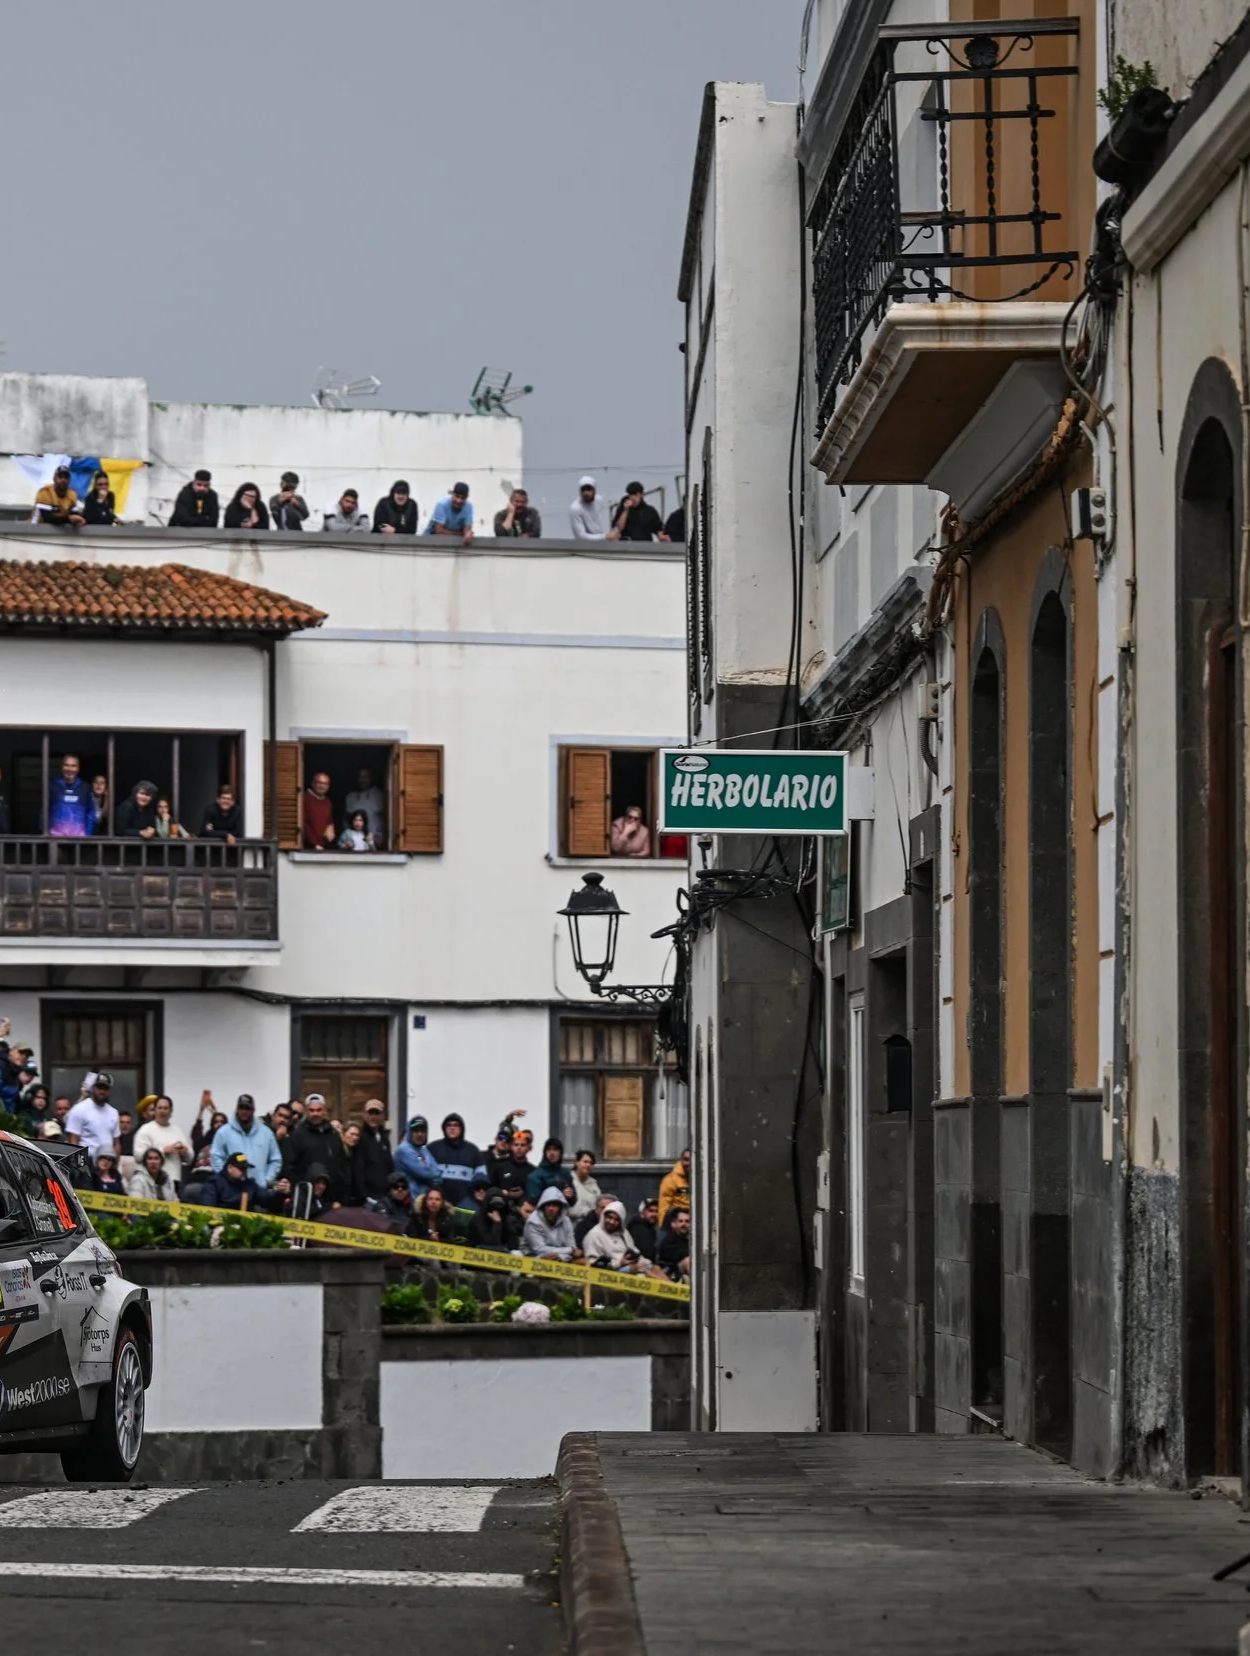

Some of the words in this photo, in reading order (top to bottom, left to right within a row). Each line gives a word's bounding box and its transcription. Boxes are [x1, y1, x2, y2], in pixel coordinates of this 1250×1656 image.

[671, 773, 837, 810] HERBOLARIO
[324, 1227, 347, 1240] ZONA
[350, 1231, 386, 1248] PUBLICO
[394, 1239, 417, 1251] ZONA
[418, 1243, 455, 1258] PUBLICO
[462, 1250, 485, 1262] ZONA
[487, 1254, 523, 1268] PUBLICO
[531, 1261, 553, 1274] ZONA
[599, 1272, 618, 1284] ZONA
[620, 1276, 650, 1291] PUBLICO
[658, 1283, 678, 1295] ZONA
